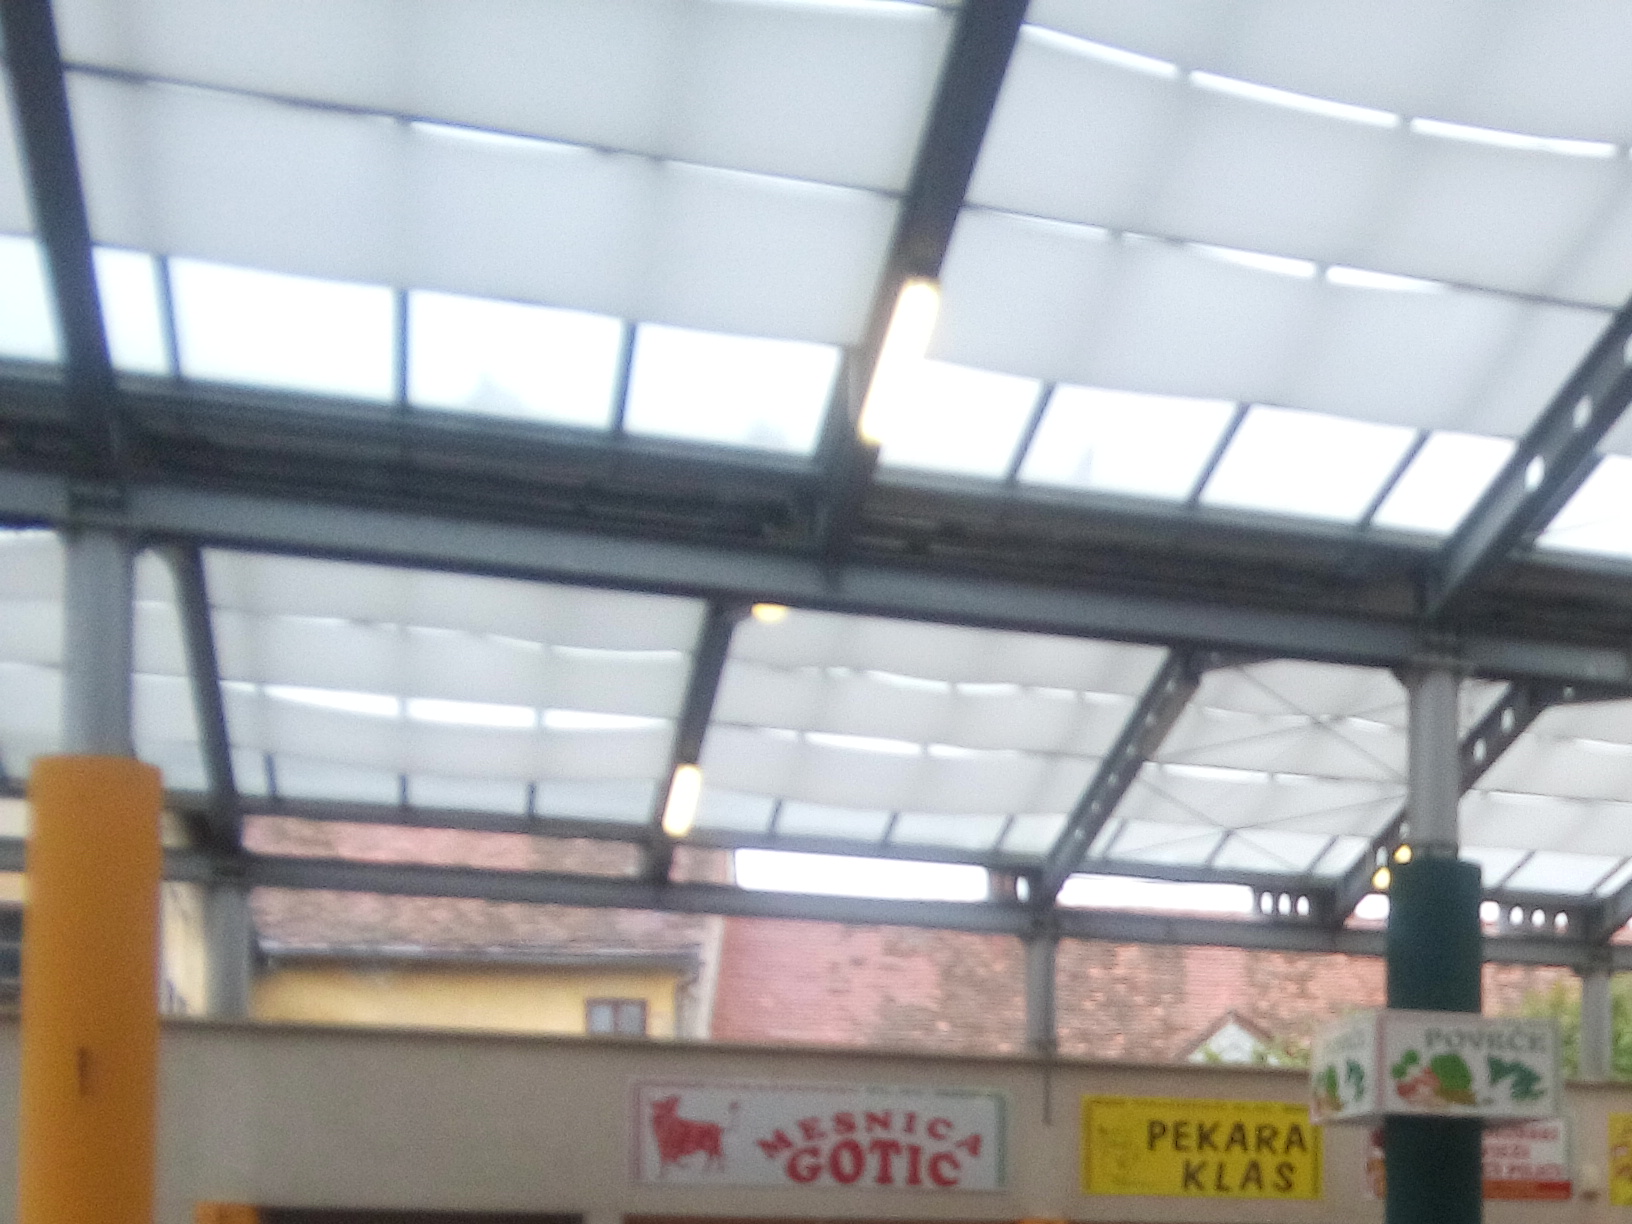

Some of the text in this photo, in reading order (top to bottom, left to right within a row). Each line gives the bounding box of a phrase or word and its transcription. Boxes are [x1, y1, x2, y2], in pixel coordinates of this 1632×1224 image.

[757, 1111, 983, 1158] MESNICA
[1147, 1119, 1307, 1154] PEKARA
[786, 1139, 961, 1187] GOTIC
[1182, 1160, 1296, 1193] KLAS
